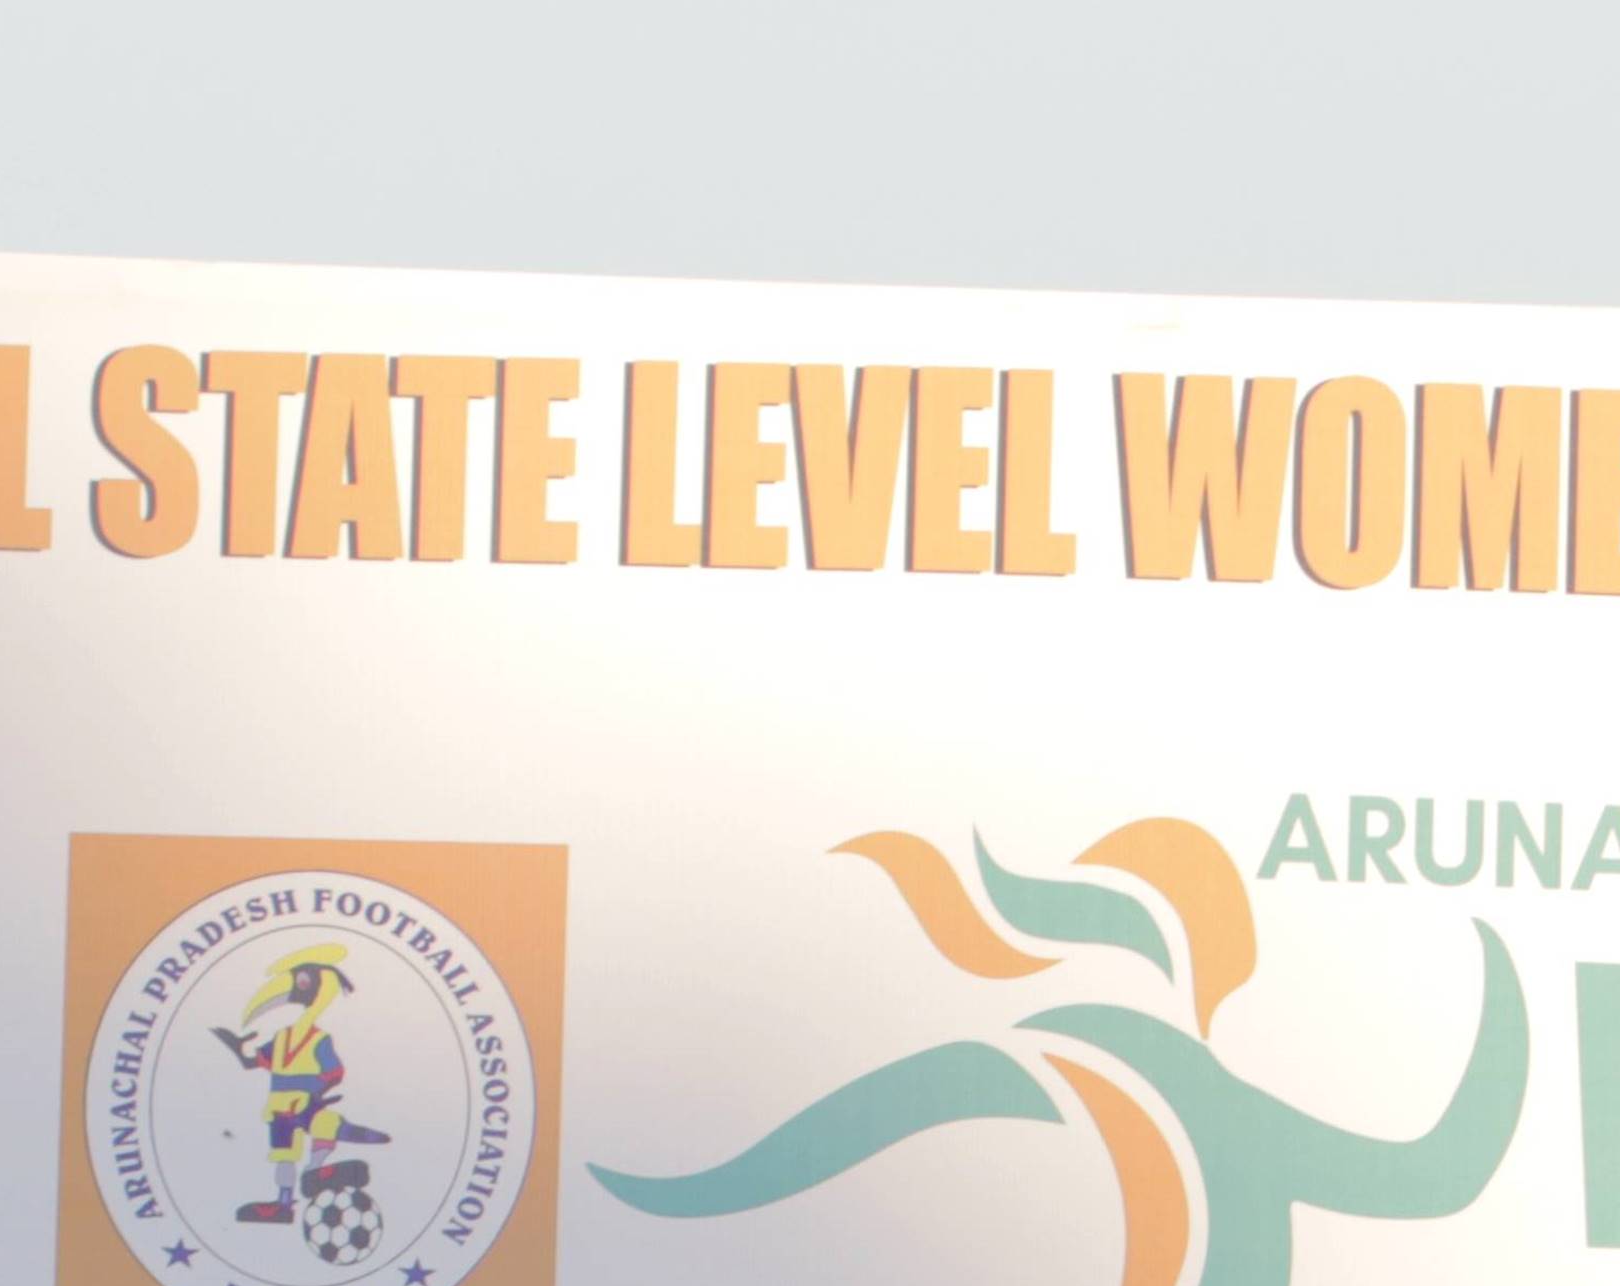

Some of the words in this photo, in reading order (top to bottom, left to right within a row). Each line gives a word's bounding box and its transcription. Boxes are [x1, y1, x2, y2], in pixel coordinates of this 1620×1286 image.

[91, 342, 580, 562] STATE
[620, 359, 1076, 579] LEVEL
[110, 1010, 165, 1222] ARUNACHAL
[144, 889, 299, 1005] PRADESH
[312, 889, 482, 1006] FOOTBALL
[441, 1011, 511, 1247] ASSOCIATION
